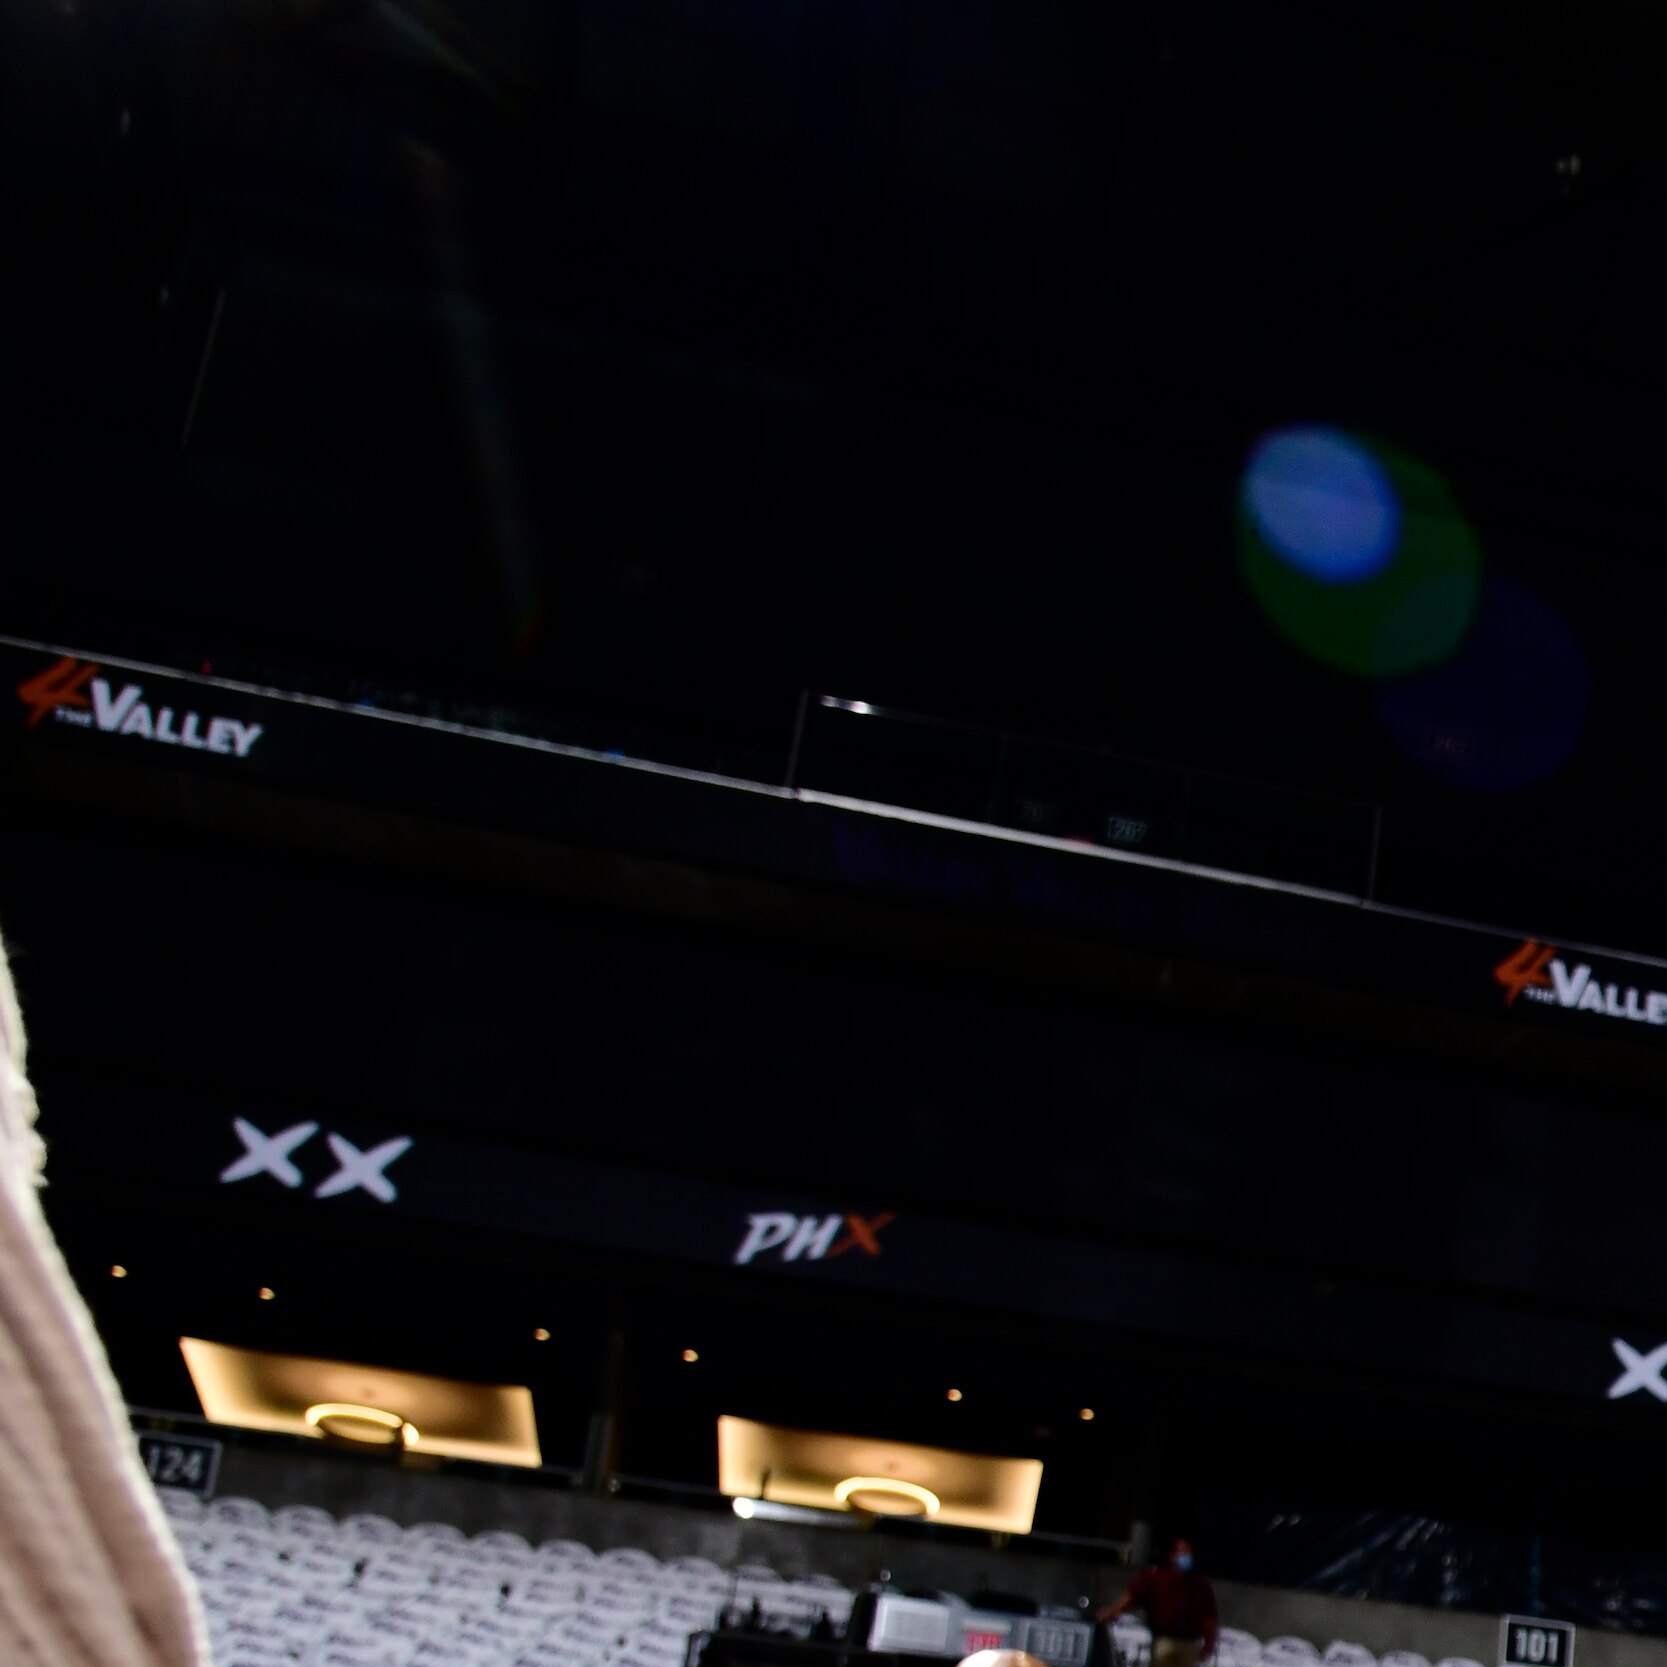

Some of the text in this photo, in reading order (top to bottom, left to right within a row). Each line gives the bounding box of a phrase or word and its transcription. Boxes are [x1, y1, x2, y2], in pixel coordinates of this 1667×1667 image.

[89, 675, 266, 758] VALLEY
[733, 1210, 897, 1267] PHX
[1514, 1626, 1559, 1666] 101
